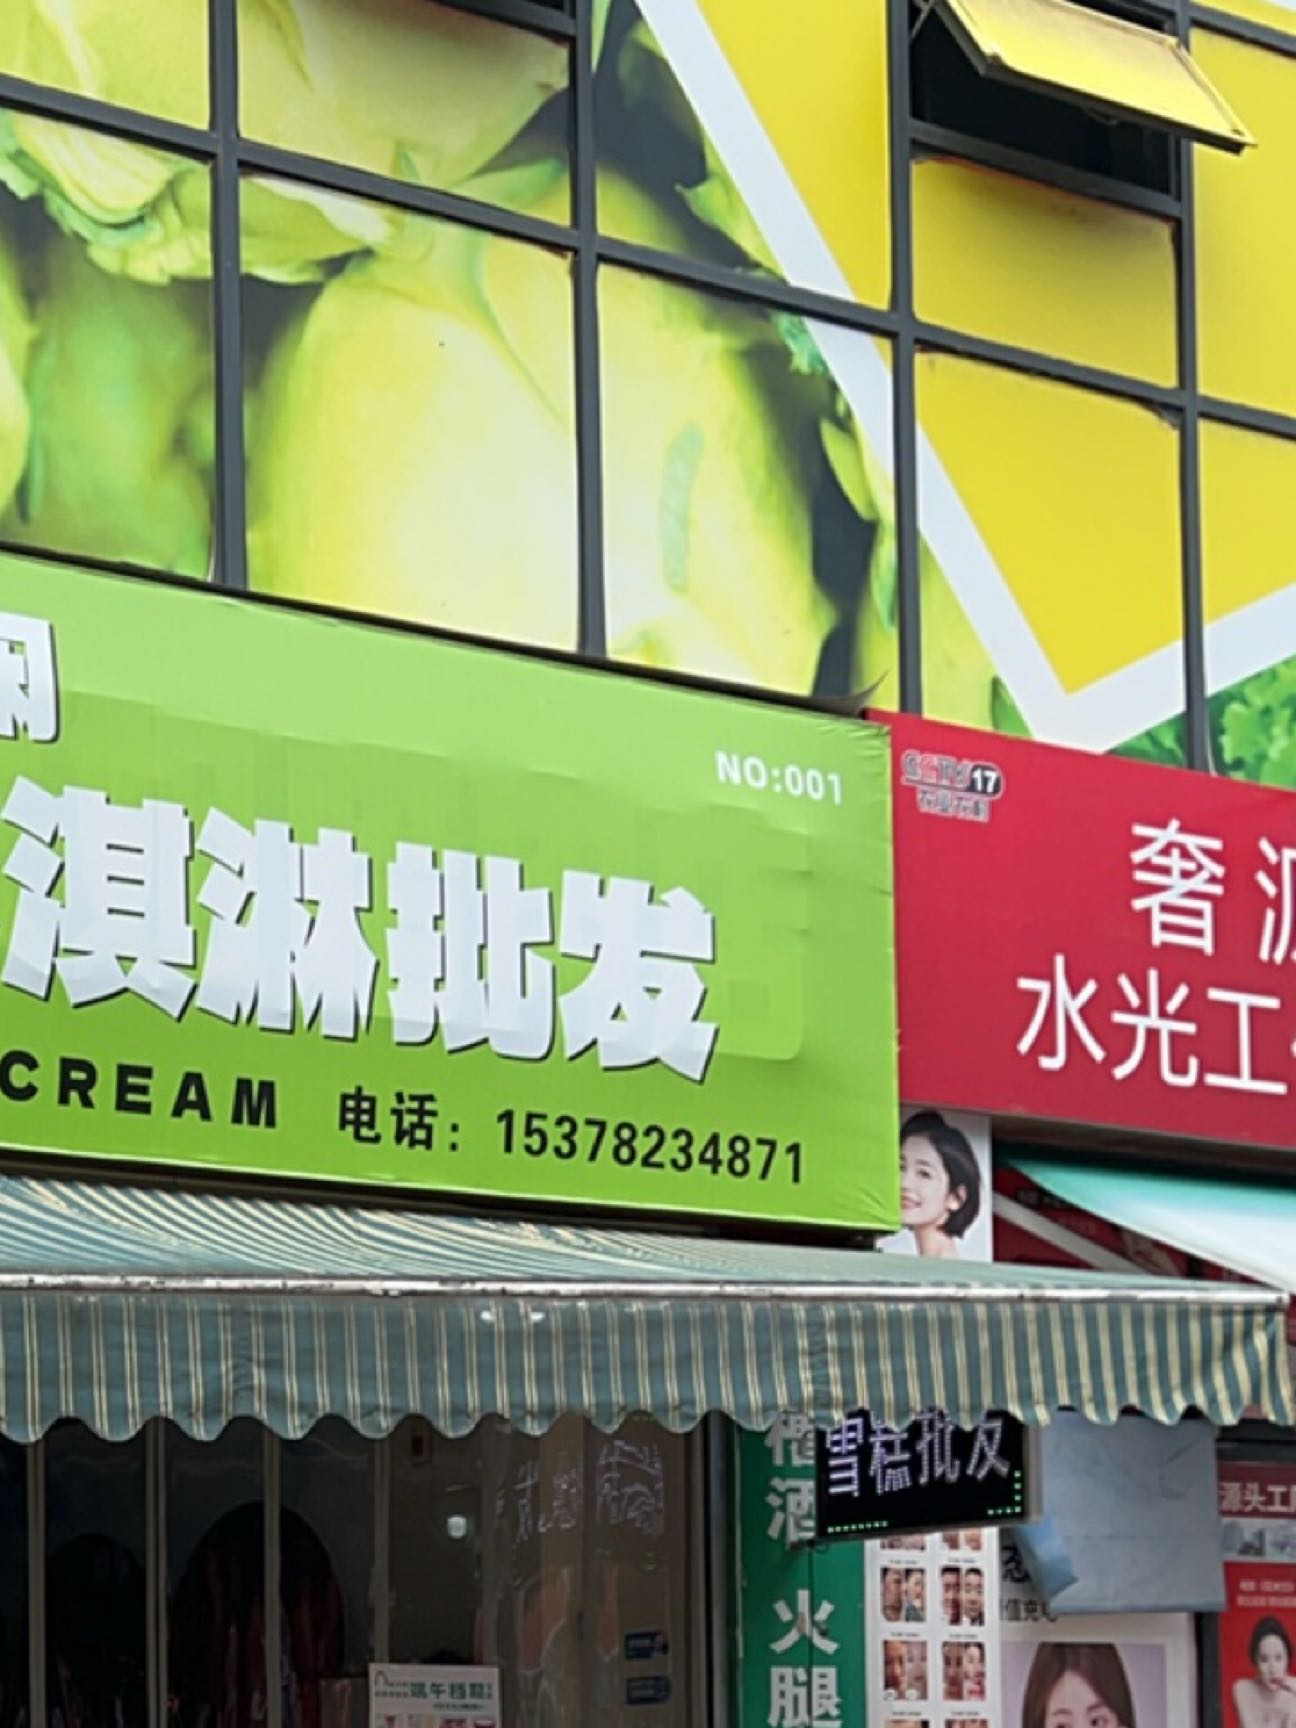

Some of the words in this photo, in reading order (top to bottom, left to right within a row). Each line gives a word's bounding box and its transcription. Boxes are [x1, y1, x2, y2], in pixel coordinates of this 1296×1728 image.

[715, 750, 842, 805] NO:001
[1017, 953, 1296, 1095] 水光工
[497, 1109, 802, 1184] 15378234871
